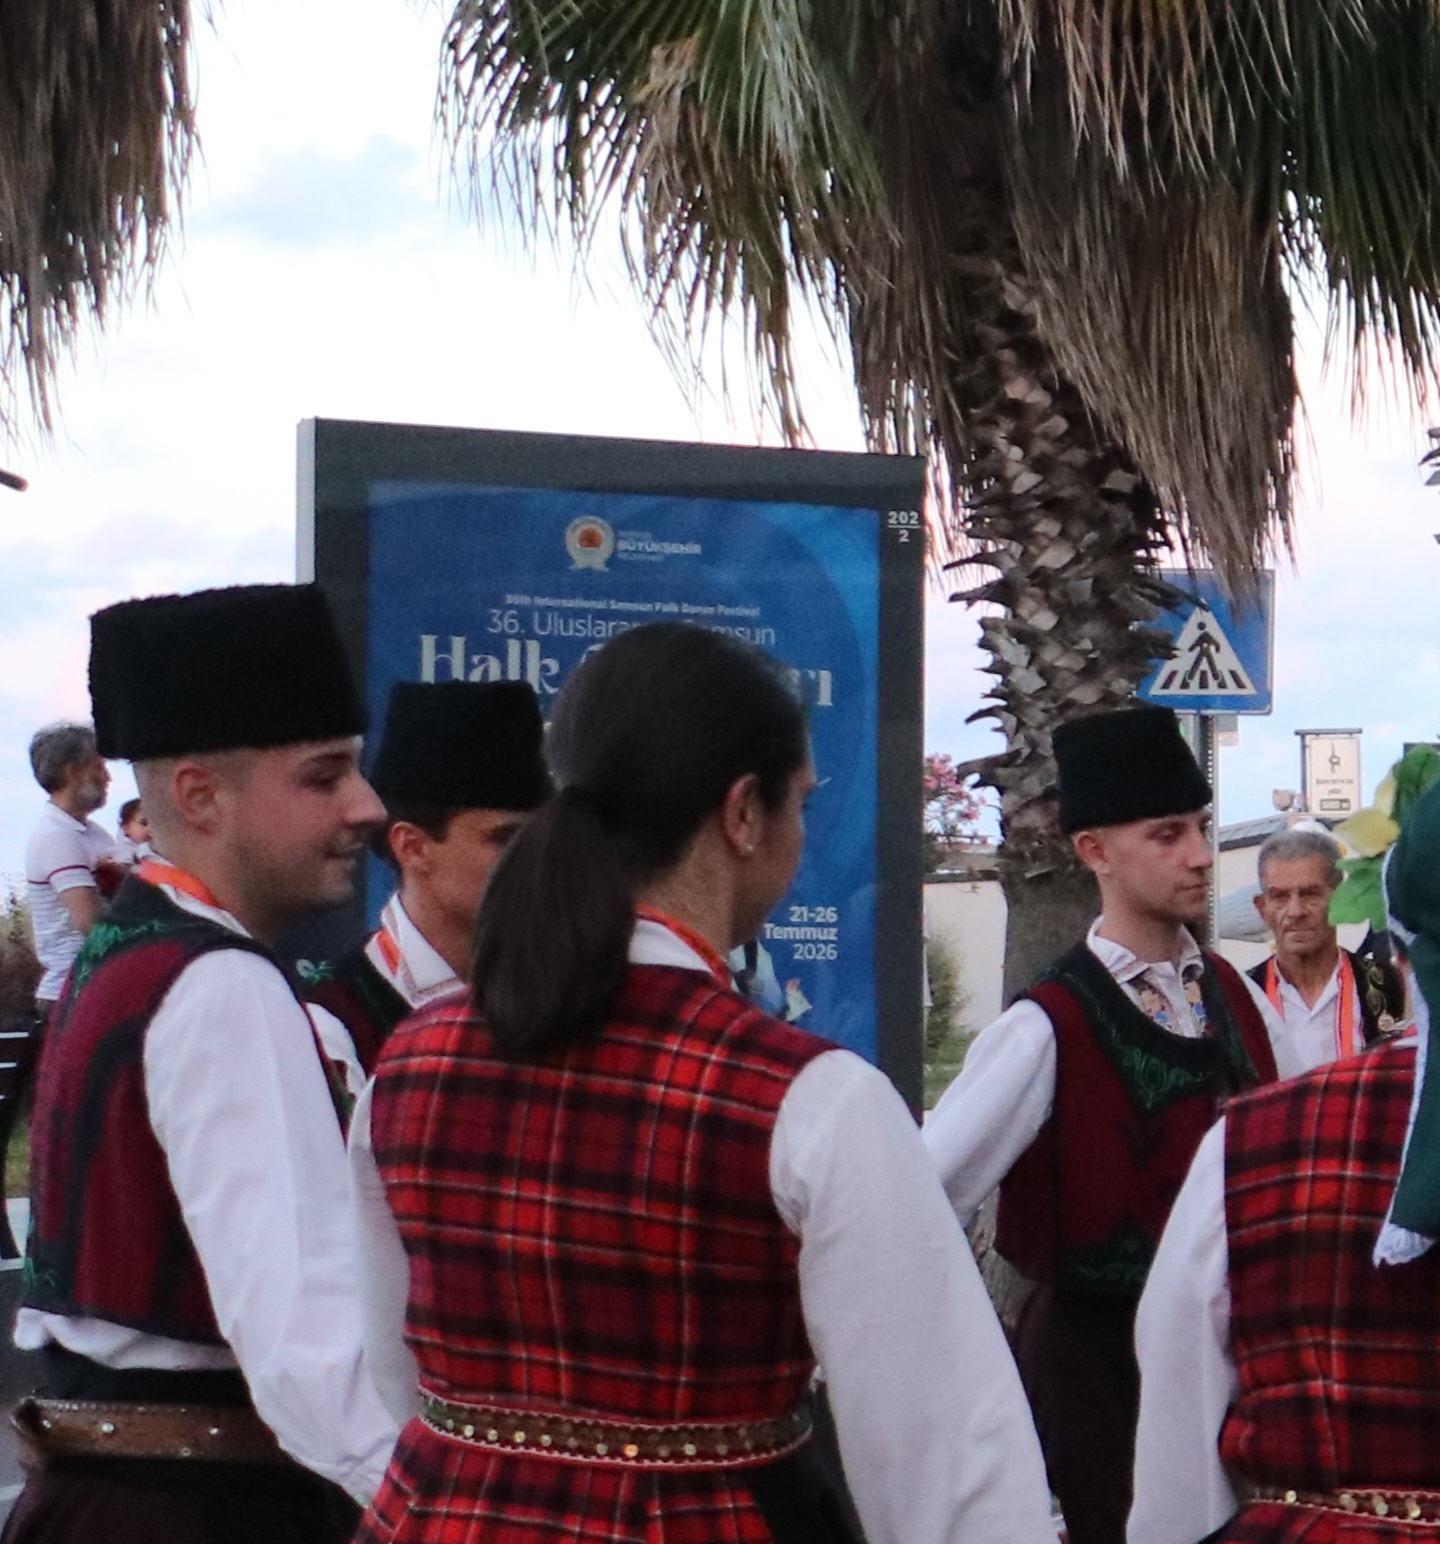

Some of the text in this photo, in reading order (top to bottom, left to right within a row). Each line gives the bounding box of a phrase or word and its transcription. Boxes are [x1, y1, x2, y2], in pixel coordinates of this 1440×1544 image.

[888, 510, 919, 524] 202
[899, 529, 910, 542] 2
[487, 609, 525, 634] 36.
[789, 905, 839, 922] 21-26
[763, 922, 839, 940] Temmuz
[793, 943, 838, 960] 2026
